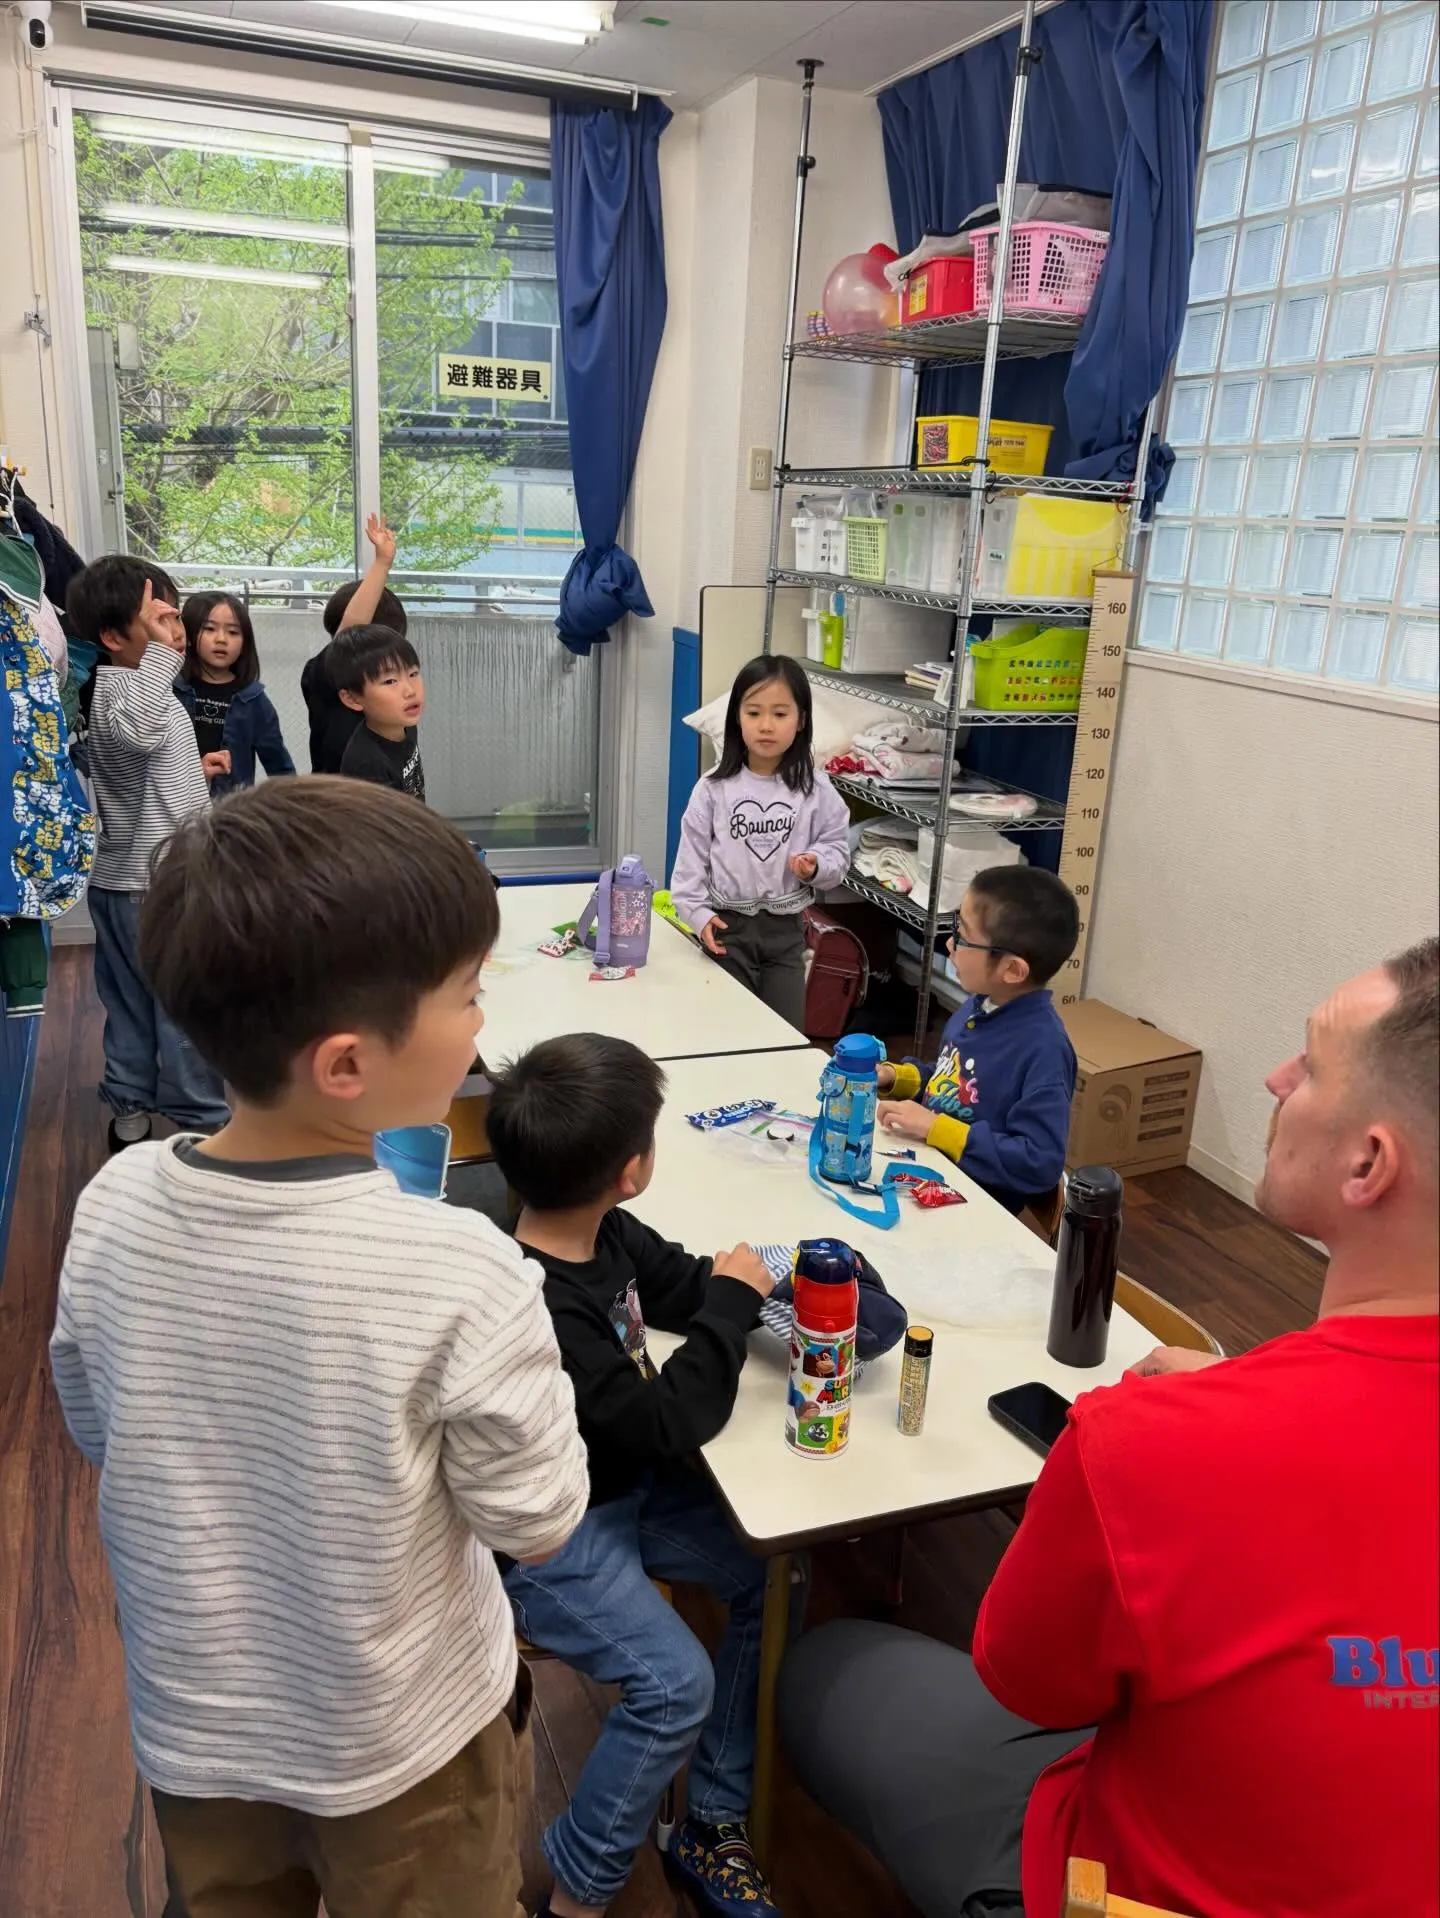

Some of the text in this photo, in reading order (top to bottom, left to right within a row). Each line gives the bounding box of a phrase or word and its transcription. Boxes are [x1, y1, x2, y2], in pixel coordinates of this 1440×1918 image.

[447, 363, 542, 393] 避難器具
[1107, 602, 1127, 615] 160
[1101, 645, 1122, 657] 150
[1096, 687, 1116, 698] 140
[1090, 728, 1110, 740] 130
[1085, 768, 1105, 779] 120
[1081, 808, 1100, 819] 110
[730, 814, 795, 844] Bouncy
[1076, 847, 1094, 858] 100
[1075, 885, 1089, 896] 90
[1066, 959, 1080, 969] 70
[1062, 995, 1076, 1005] 60
